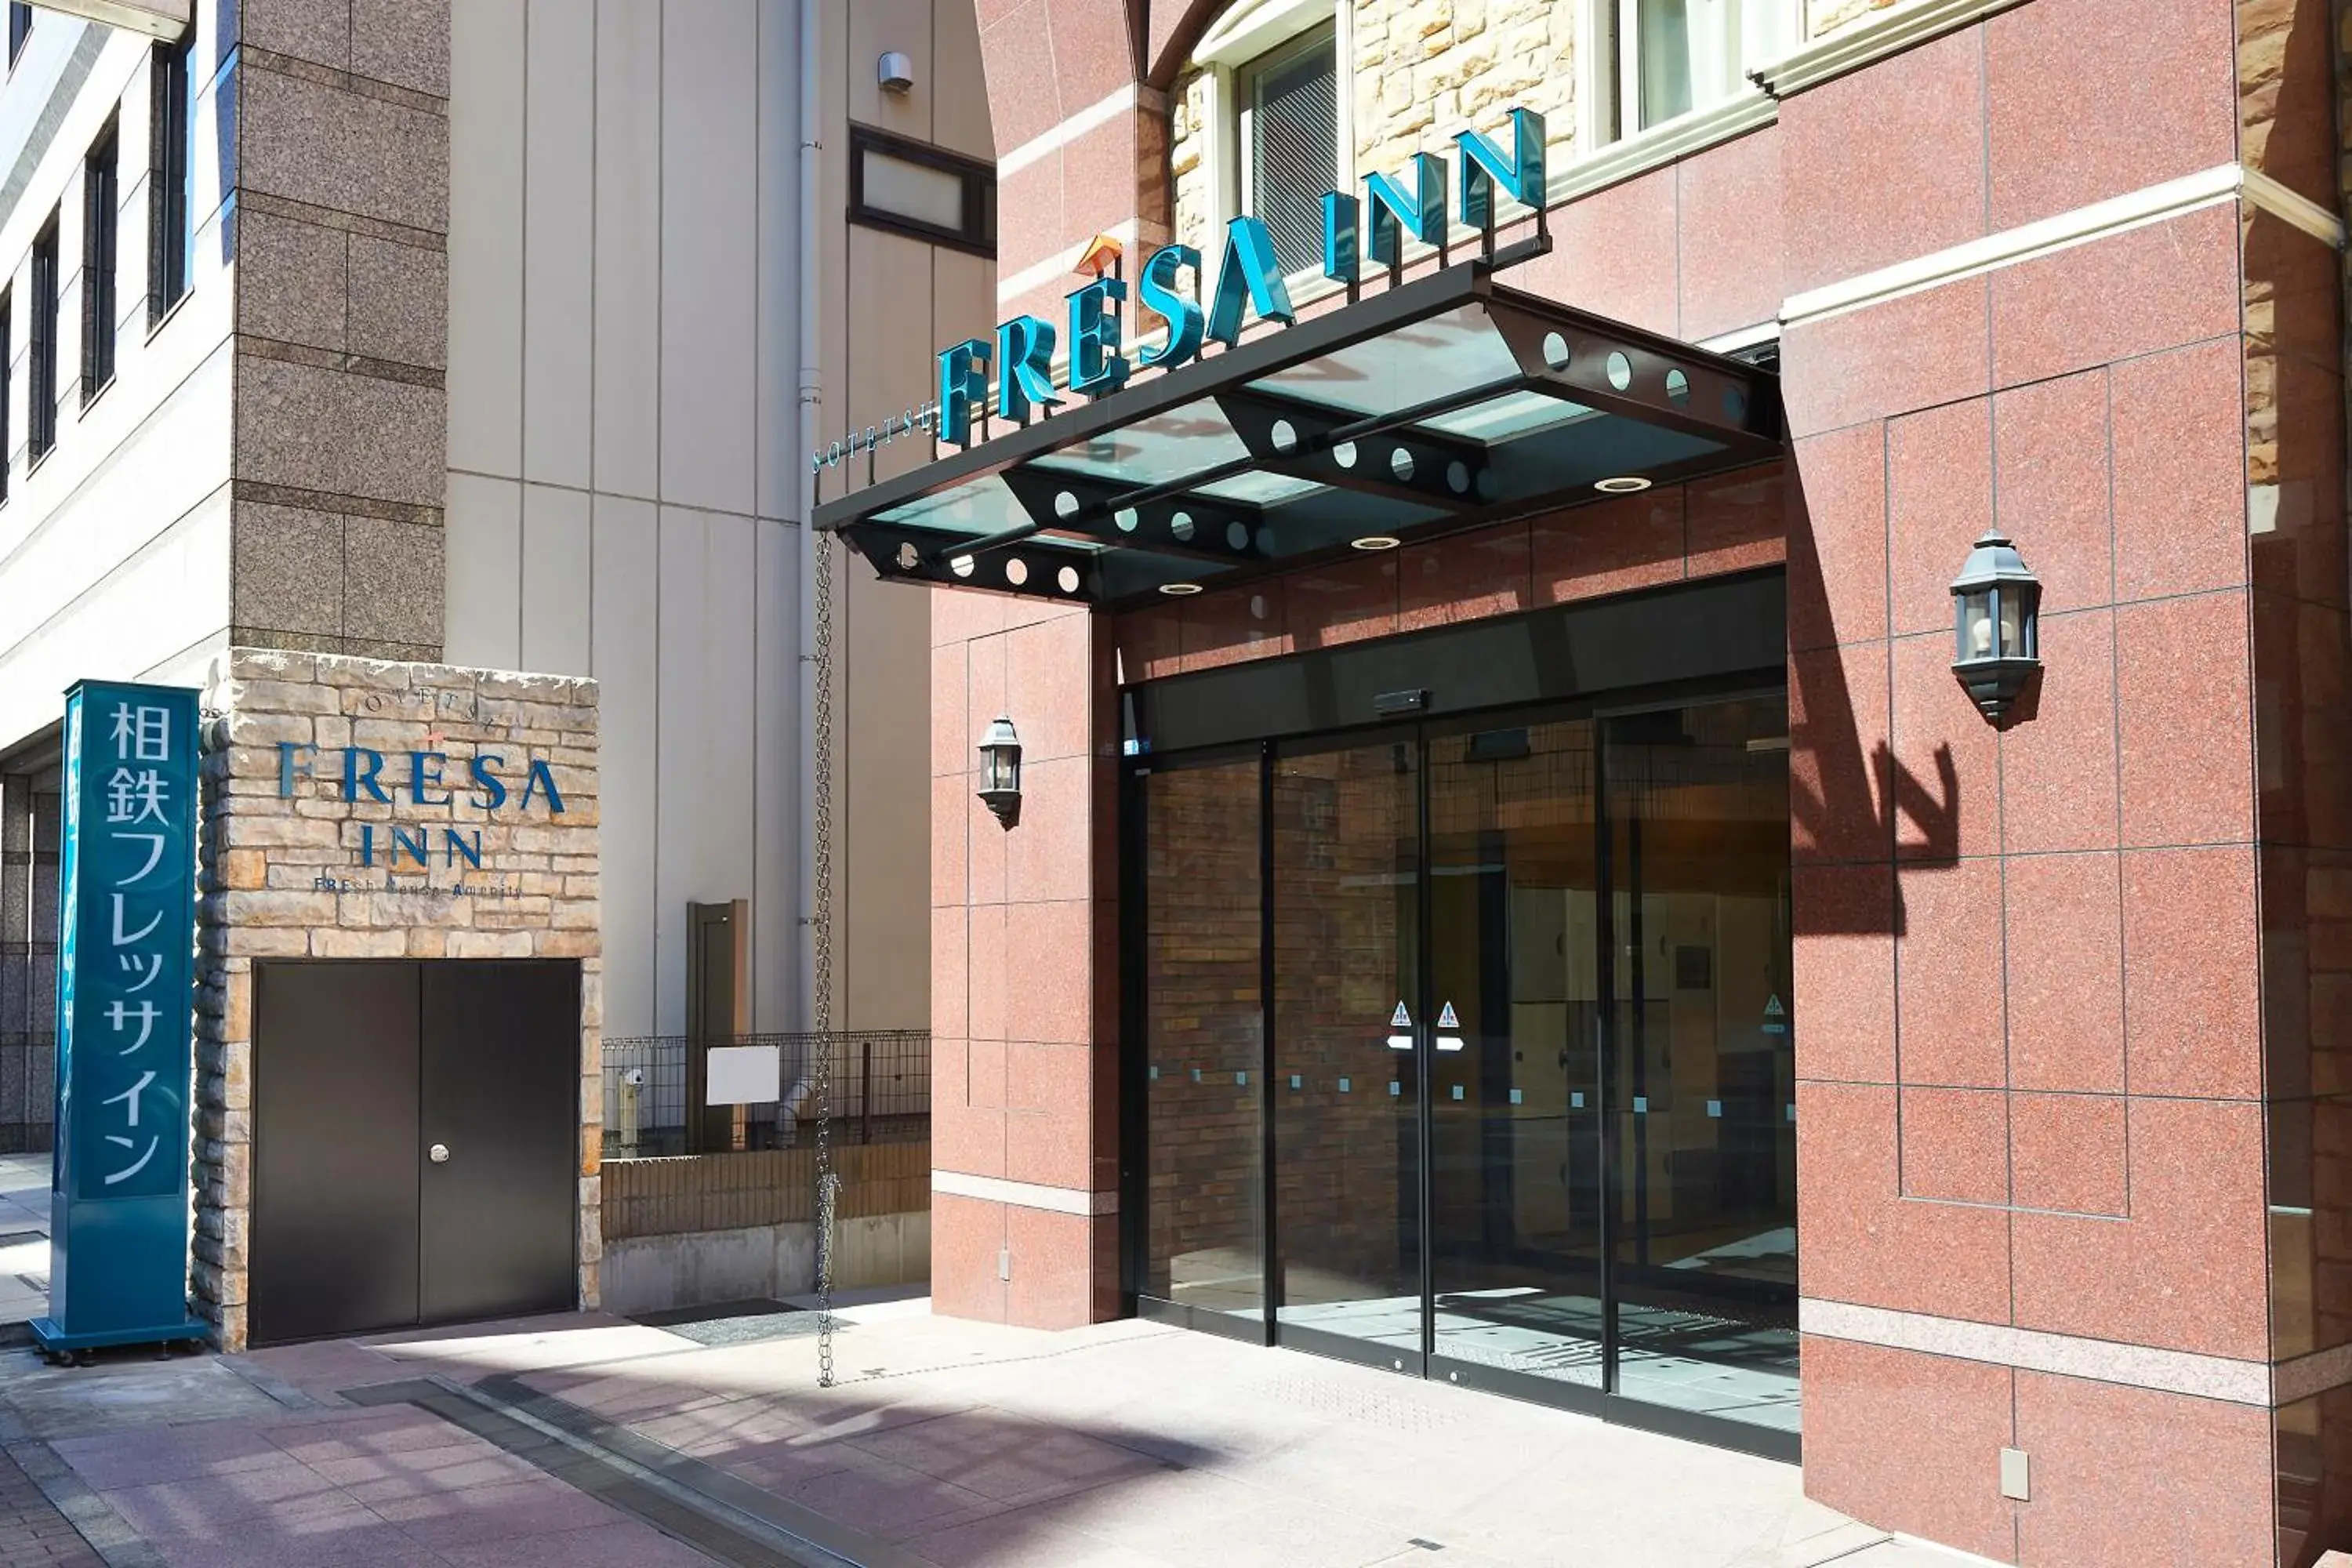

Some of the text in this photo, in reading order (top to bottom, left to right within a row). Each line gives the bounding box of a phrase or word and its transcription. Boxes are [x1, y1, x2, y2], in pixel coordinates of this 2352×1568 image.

[811, 401, 935, 474] SOTETSU
[1320, 107, 1546, 283] INN
[276, 741, 565, 813] FRESA
[361, 825, 481, 869] INN
[101, 702, 170, 1185] 相鉄フレッサイン
